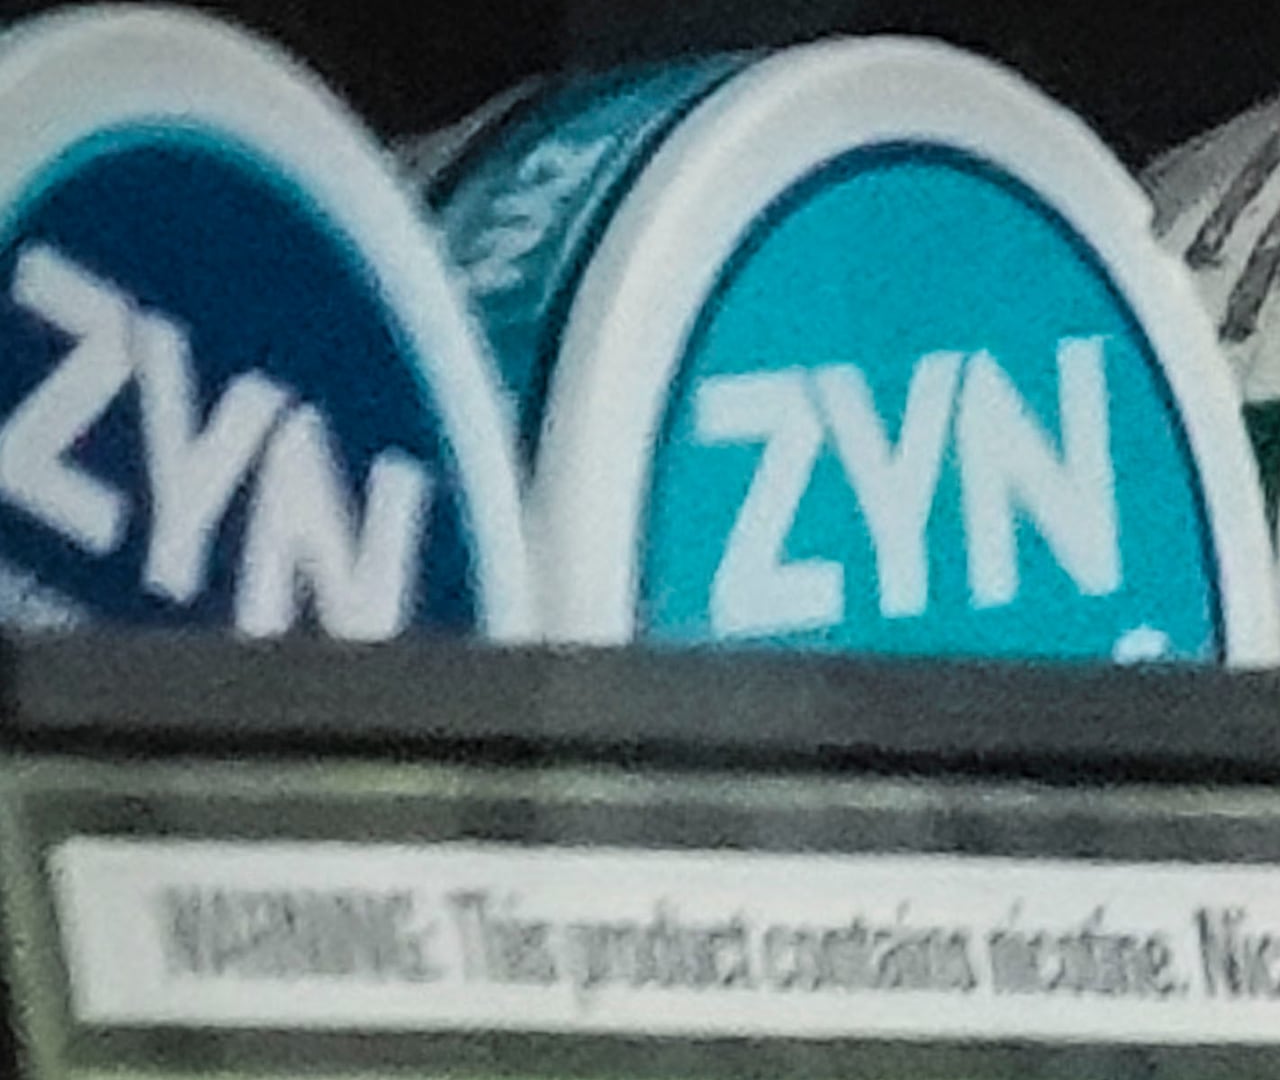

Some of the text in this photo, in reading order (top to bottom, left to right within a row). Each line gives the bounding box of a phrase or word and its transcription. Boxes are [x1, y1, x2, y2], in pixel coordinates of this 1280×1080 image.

[0, 242, 432, 640] ZYN
[694, 333, 1122, 640] ZYN
[446, 888, 556, 986] This
[562, 898, 746, 1012] product
[763, 898, 977, 992] contains
[987, 898, 1190, 996] nicotine.
